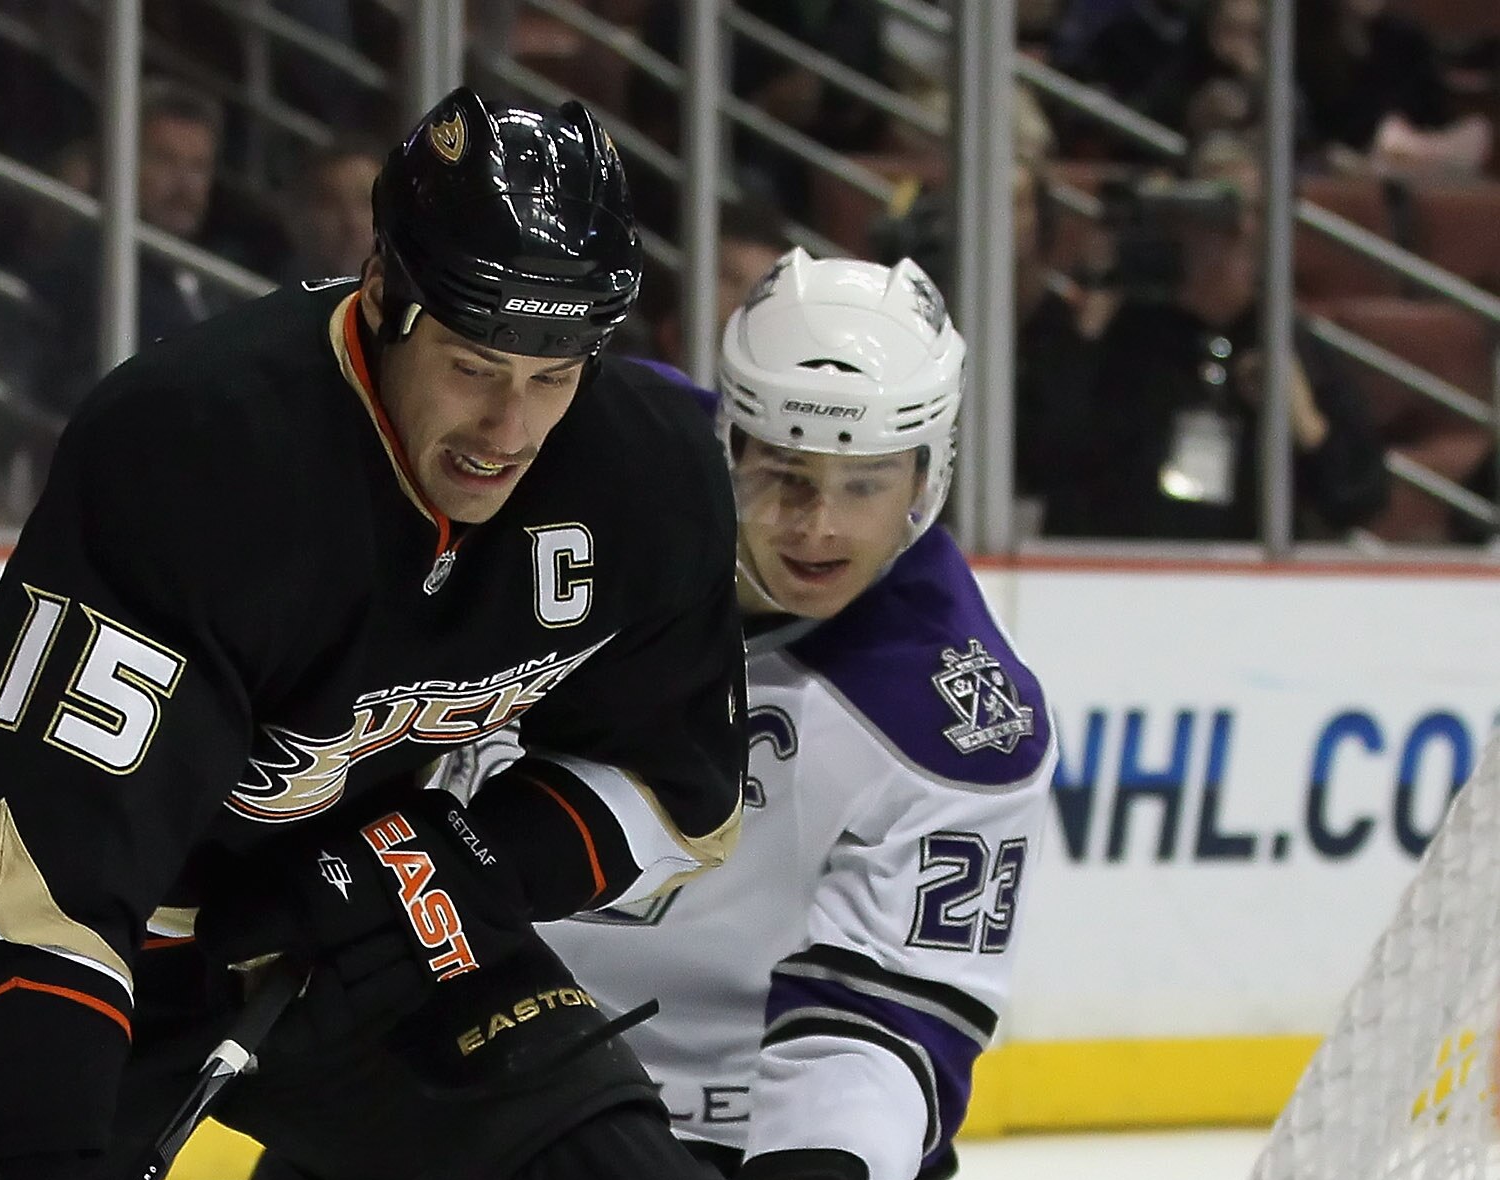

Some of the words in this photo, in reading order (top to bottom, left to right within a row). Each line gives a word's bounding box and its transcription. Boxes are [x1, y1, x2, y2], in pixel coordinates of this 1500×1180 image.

[505, 298, 589, 316] BAUER
[784, 400, 861, 418] BAUER
[524, 521, 594, 629] C
[356, 651, 558, 705] ANAHEIM
[1052, 708, 1500, 864] NHL.CO
[447, 811, 496, 866] GETZLAF
[360, 811, 480, 982] EAST
[904, 830, 1028, 954] 23
